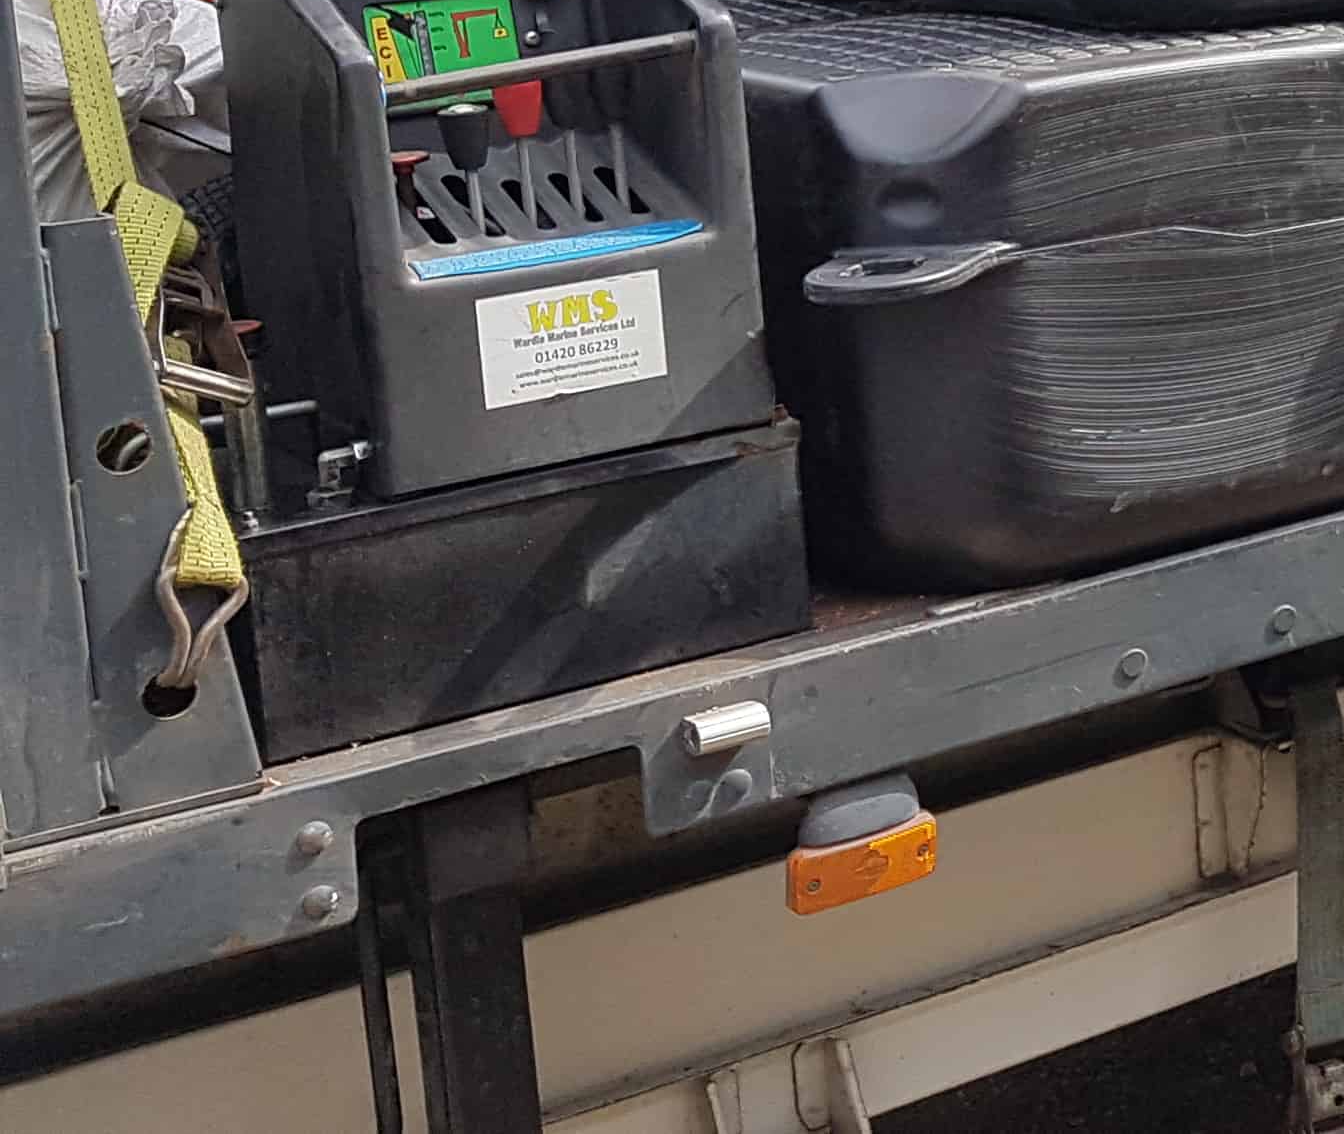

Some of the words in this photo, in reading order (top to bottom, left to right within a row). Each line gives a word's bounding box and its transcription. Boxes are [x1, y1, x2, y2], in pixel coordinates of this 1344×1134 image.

[526, 289, 618, 334] WMS
[547, 330, 578, 342] Marine
[580, 322, 618, 336] Services
[620, 318, 636, 329] Ltd
[535, 346, 575, 363] 01420
[579, 338, 618, 355] 86229
